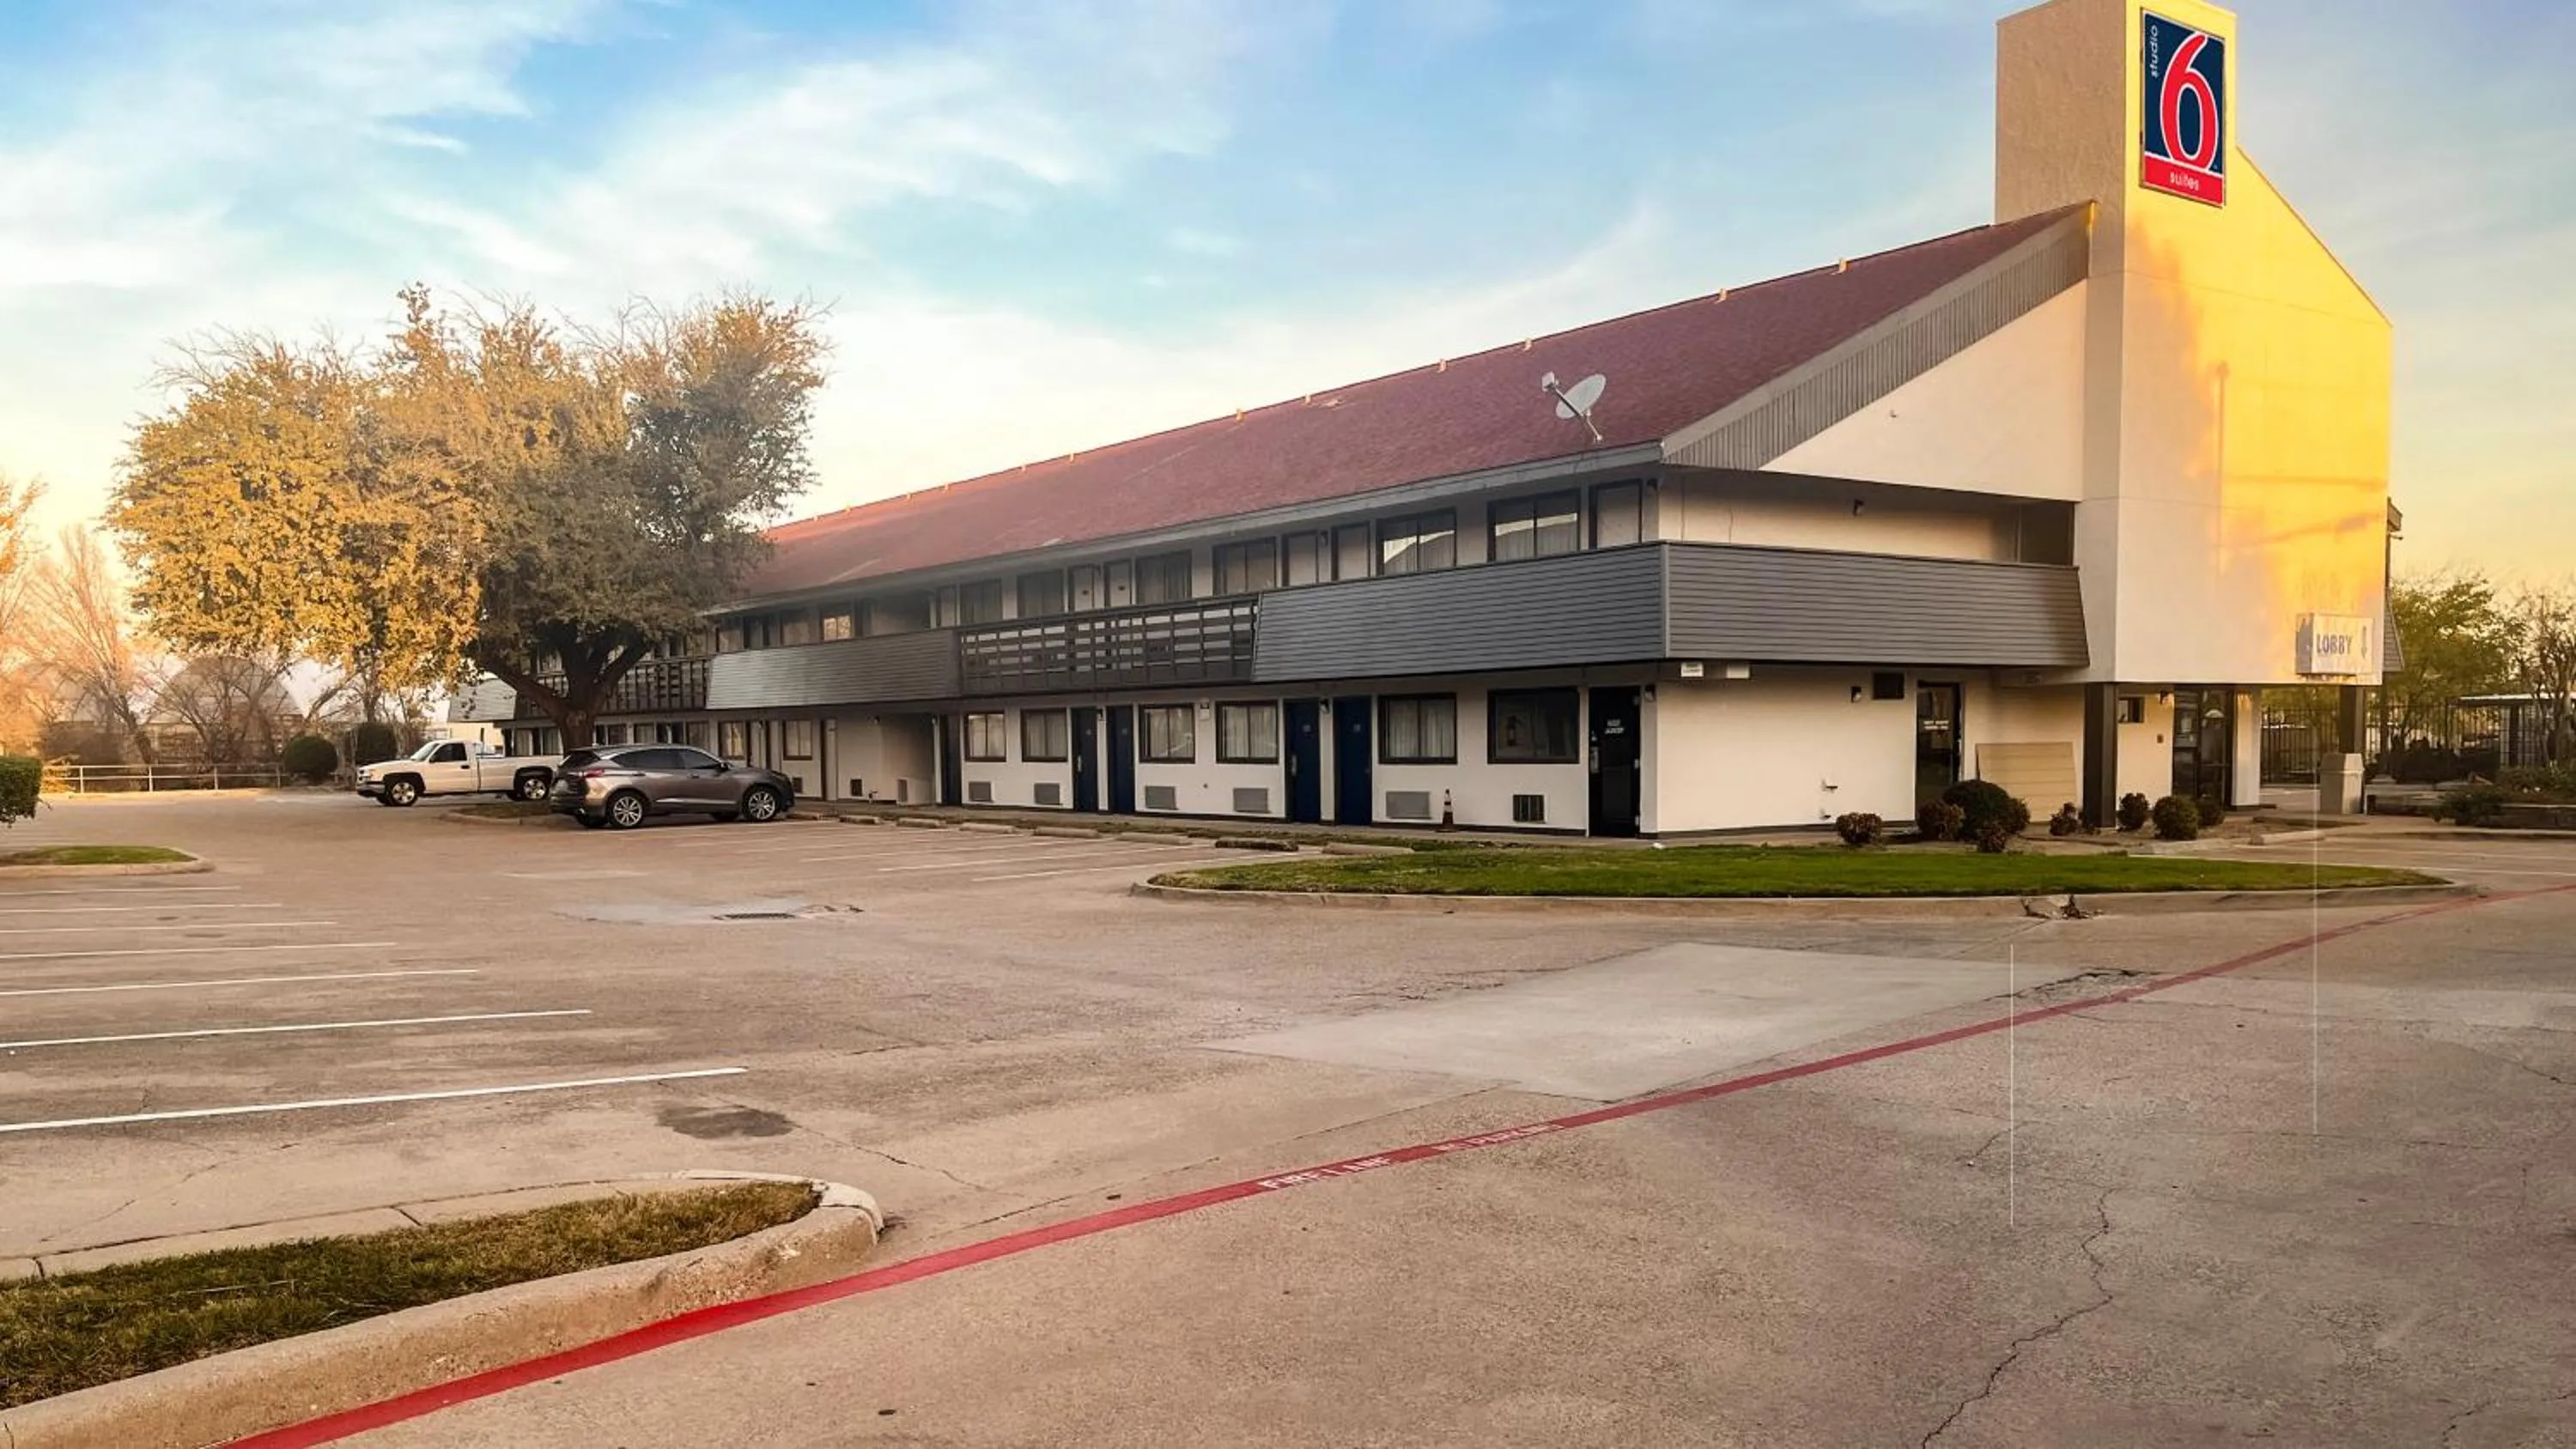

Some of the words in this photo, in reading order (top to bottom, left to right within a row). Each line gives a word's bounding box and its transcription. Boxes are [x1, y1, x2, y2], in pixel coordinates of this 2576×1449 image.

[2149, 25, 2159, 78] studio
[2160, 32, 2219, 170] 6
[2170, 171, 2199, 191] suites
[2316, 633, 2354, 655] LOBBY
